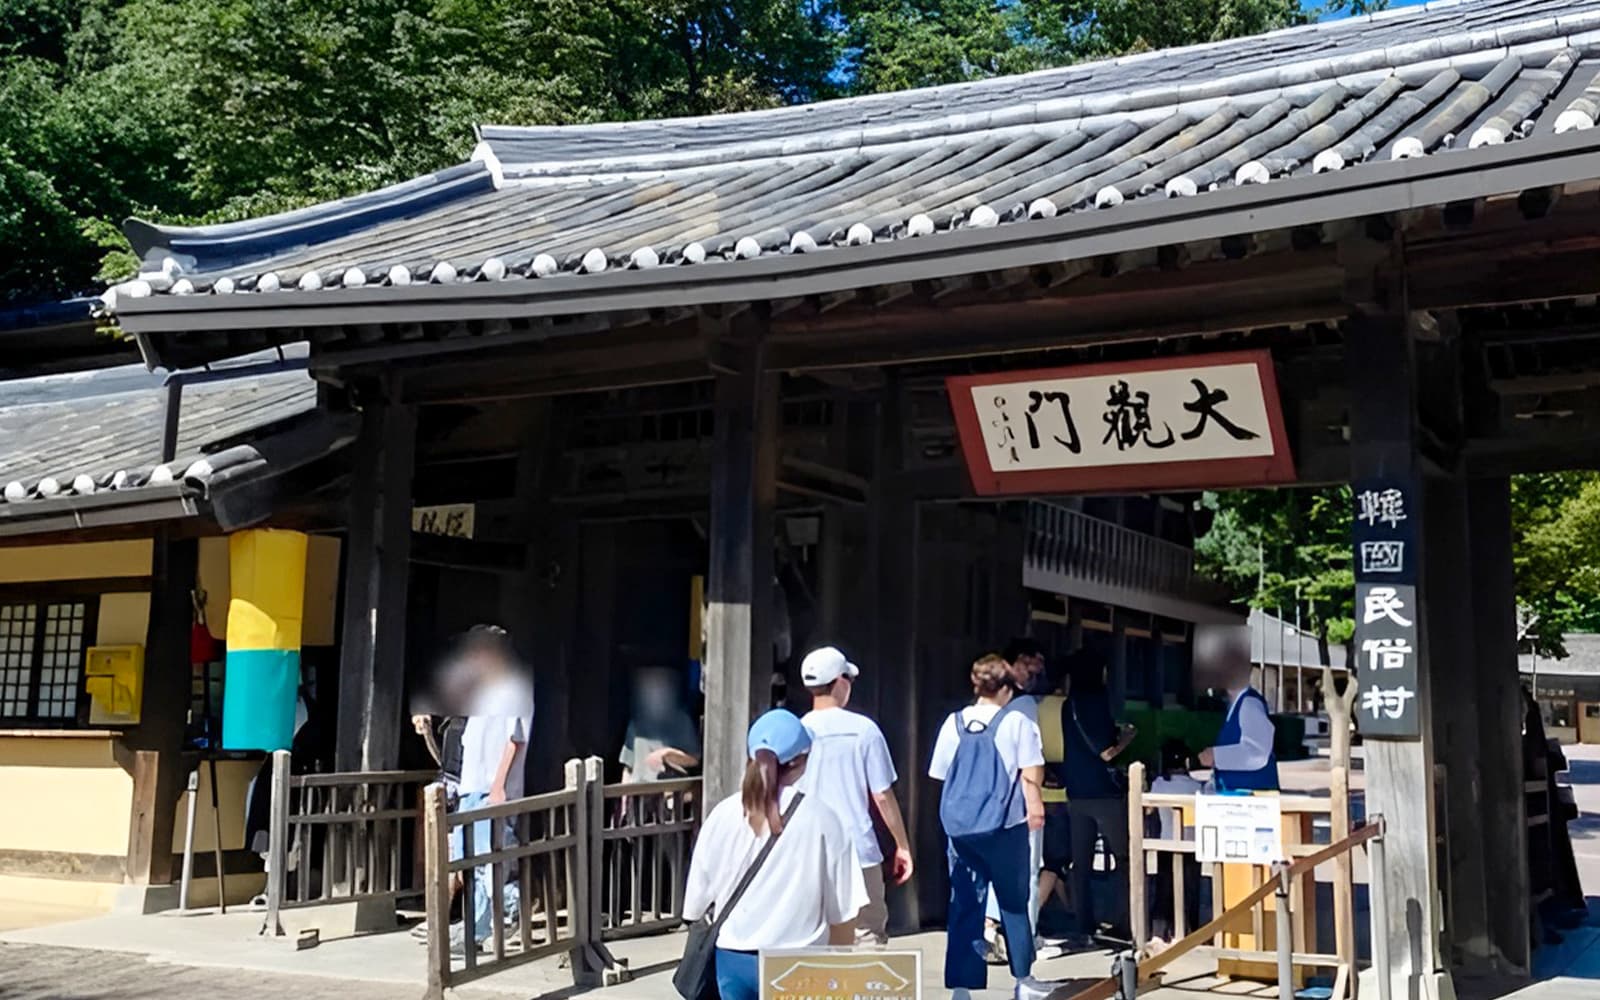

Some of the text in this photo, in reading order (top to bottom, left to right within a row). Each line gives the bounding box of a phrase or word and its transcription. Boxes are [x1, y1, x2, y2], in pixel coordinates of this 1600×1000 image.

[1357, 489, 1414, 720] 韓國民俗村
